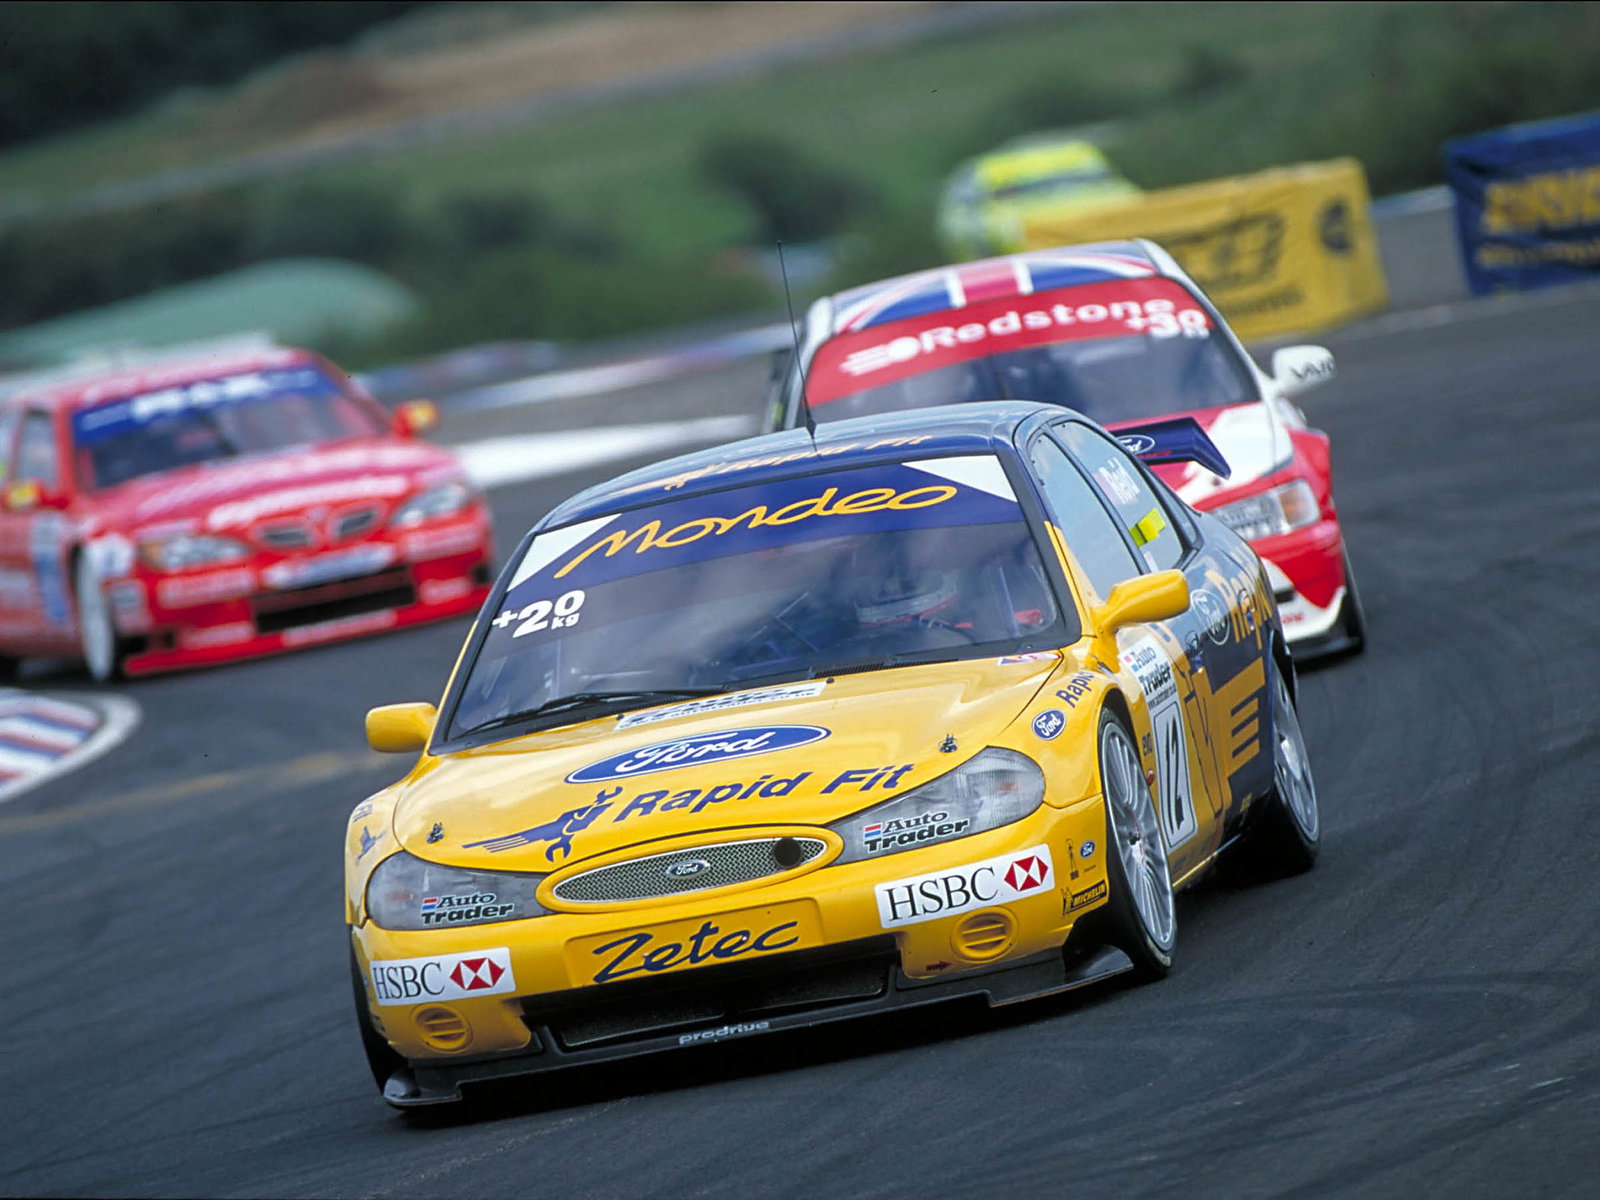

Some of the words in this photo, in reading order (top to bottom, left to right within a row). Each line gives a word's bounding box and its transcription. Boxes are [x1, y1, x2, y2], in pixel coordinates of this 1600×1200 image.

[919, 298, 1175, 356] Redstone
[553, 485, 958, 579] Mondeo
[492, 589, 585, 639] +20
[551, 612, 580, 630] kg
[1036, 711, 1062, 738] Ford
[614, 731, 777, 773] Ford
[613, 771, 813, 823] Rapid
[820, 763, 916, 795] Fit
[864, 819, 969, 852] Trader
[883, 811, 948, 834] Auto
[674, 862, 700, 877] Ford
[436, 893, 496, 909] Auto
[885, 866, 999, 922] HSBC
[421, 903, 514, 924] Trader
[592, 920, 799, 983] Zetec
[372, 962, 446, 1001] HSBC
[679, 1020, 770, 1046] prodrive
